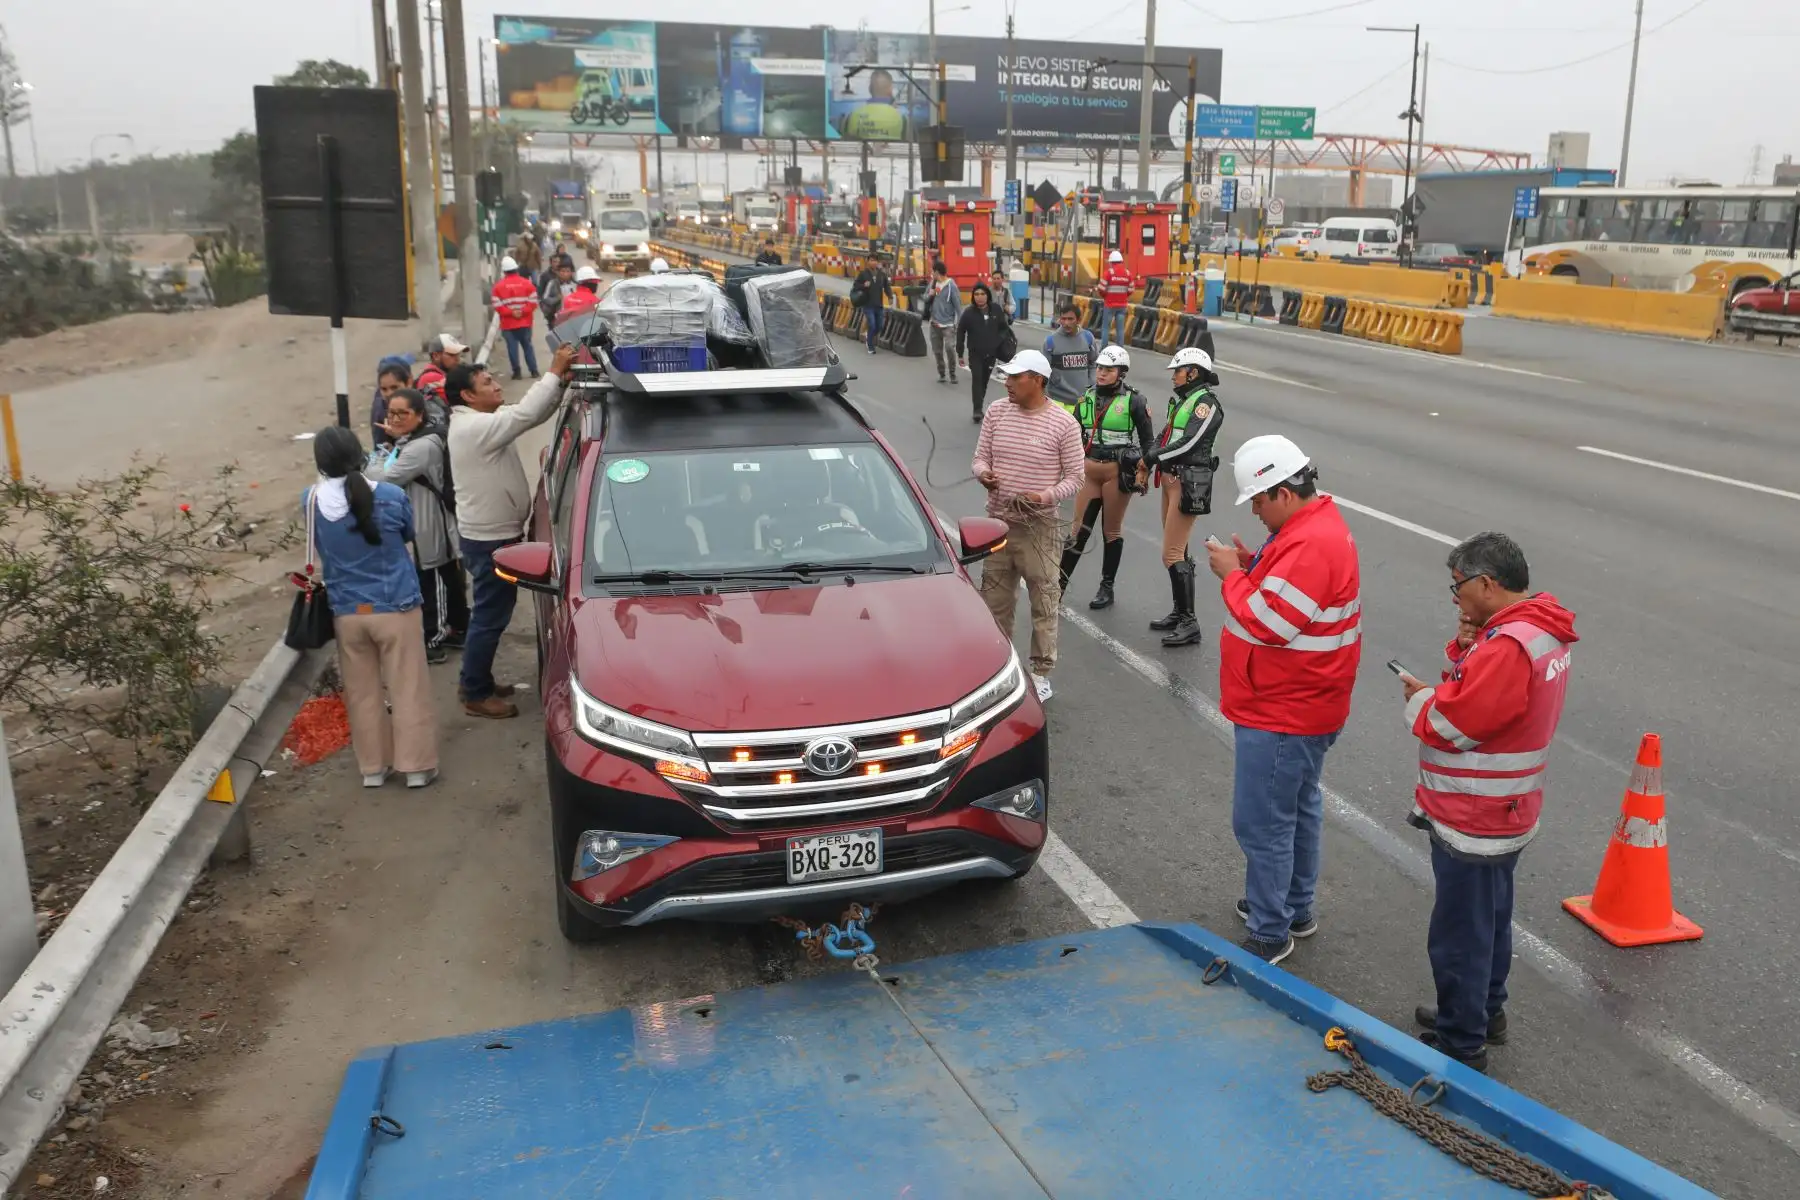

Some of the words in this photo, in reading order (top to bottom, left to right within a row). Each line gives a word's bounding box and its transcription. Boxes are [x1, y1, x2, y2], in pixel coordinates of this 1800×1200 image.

[998, 71, 1068, 88] INTEGRAL
[1092, 76, 1171, 92] SEGURIAD
[1072, 96, 1084, 106] tu
[1087, 96, 1128, 109] servicio
[818, 835, 851, 846] PERU
[792, 841, 877, 875] BXQ-328
